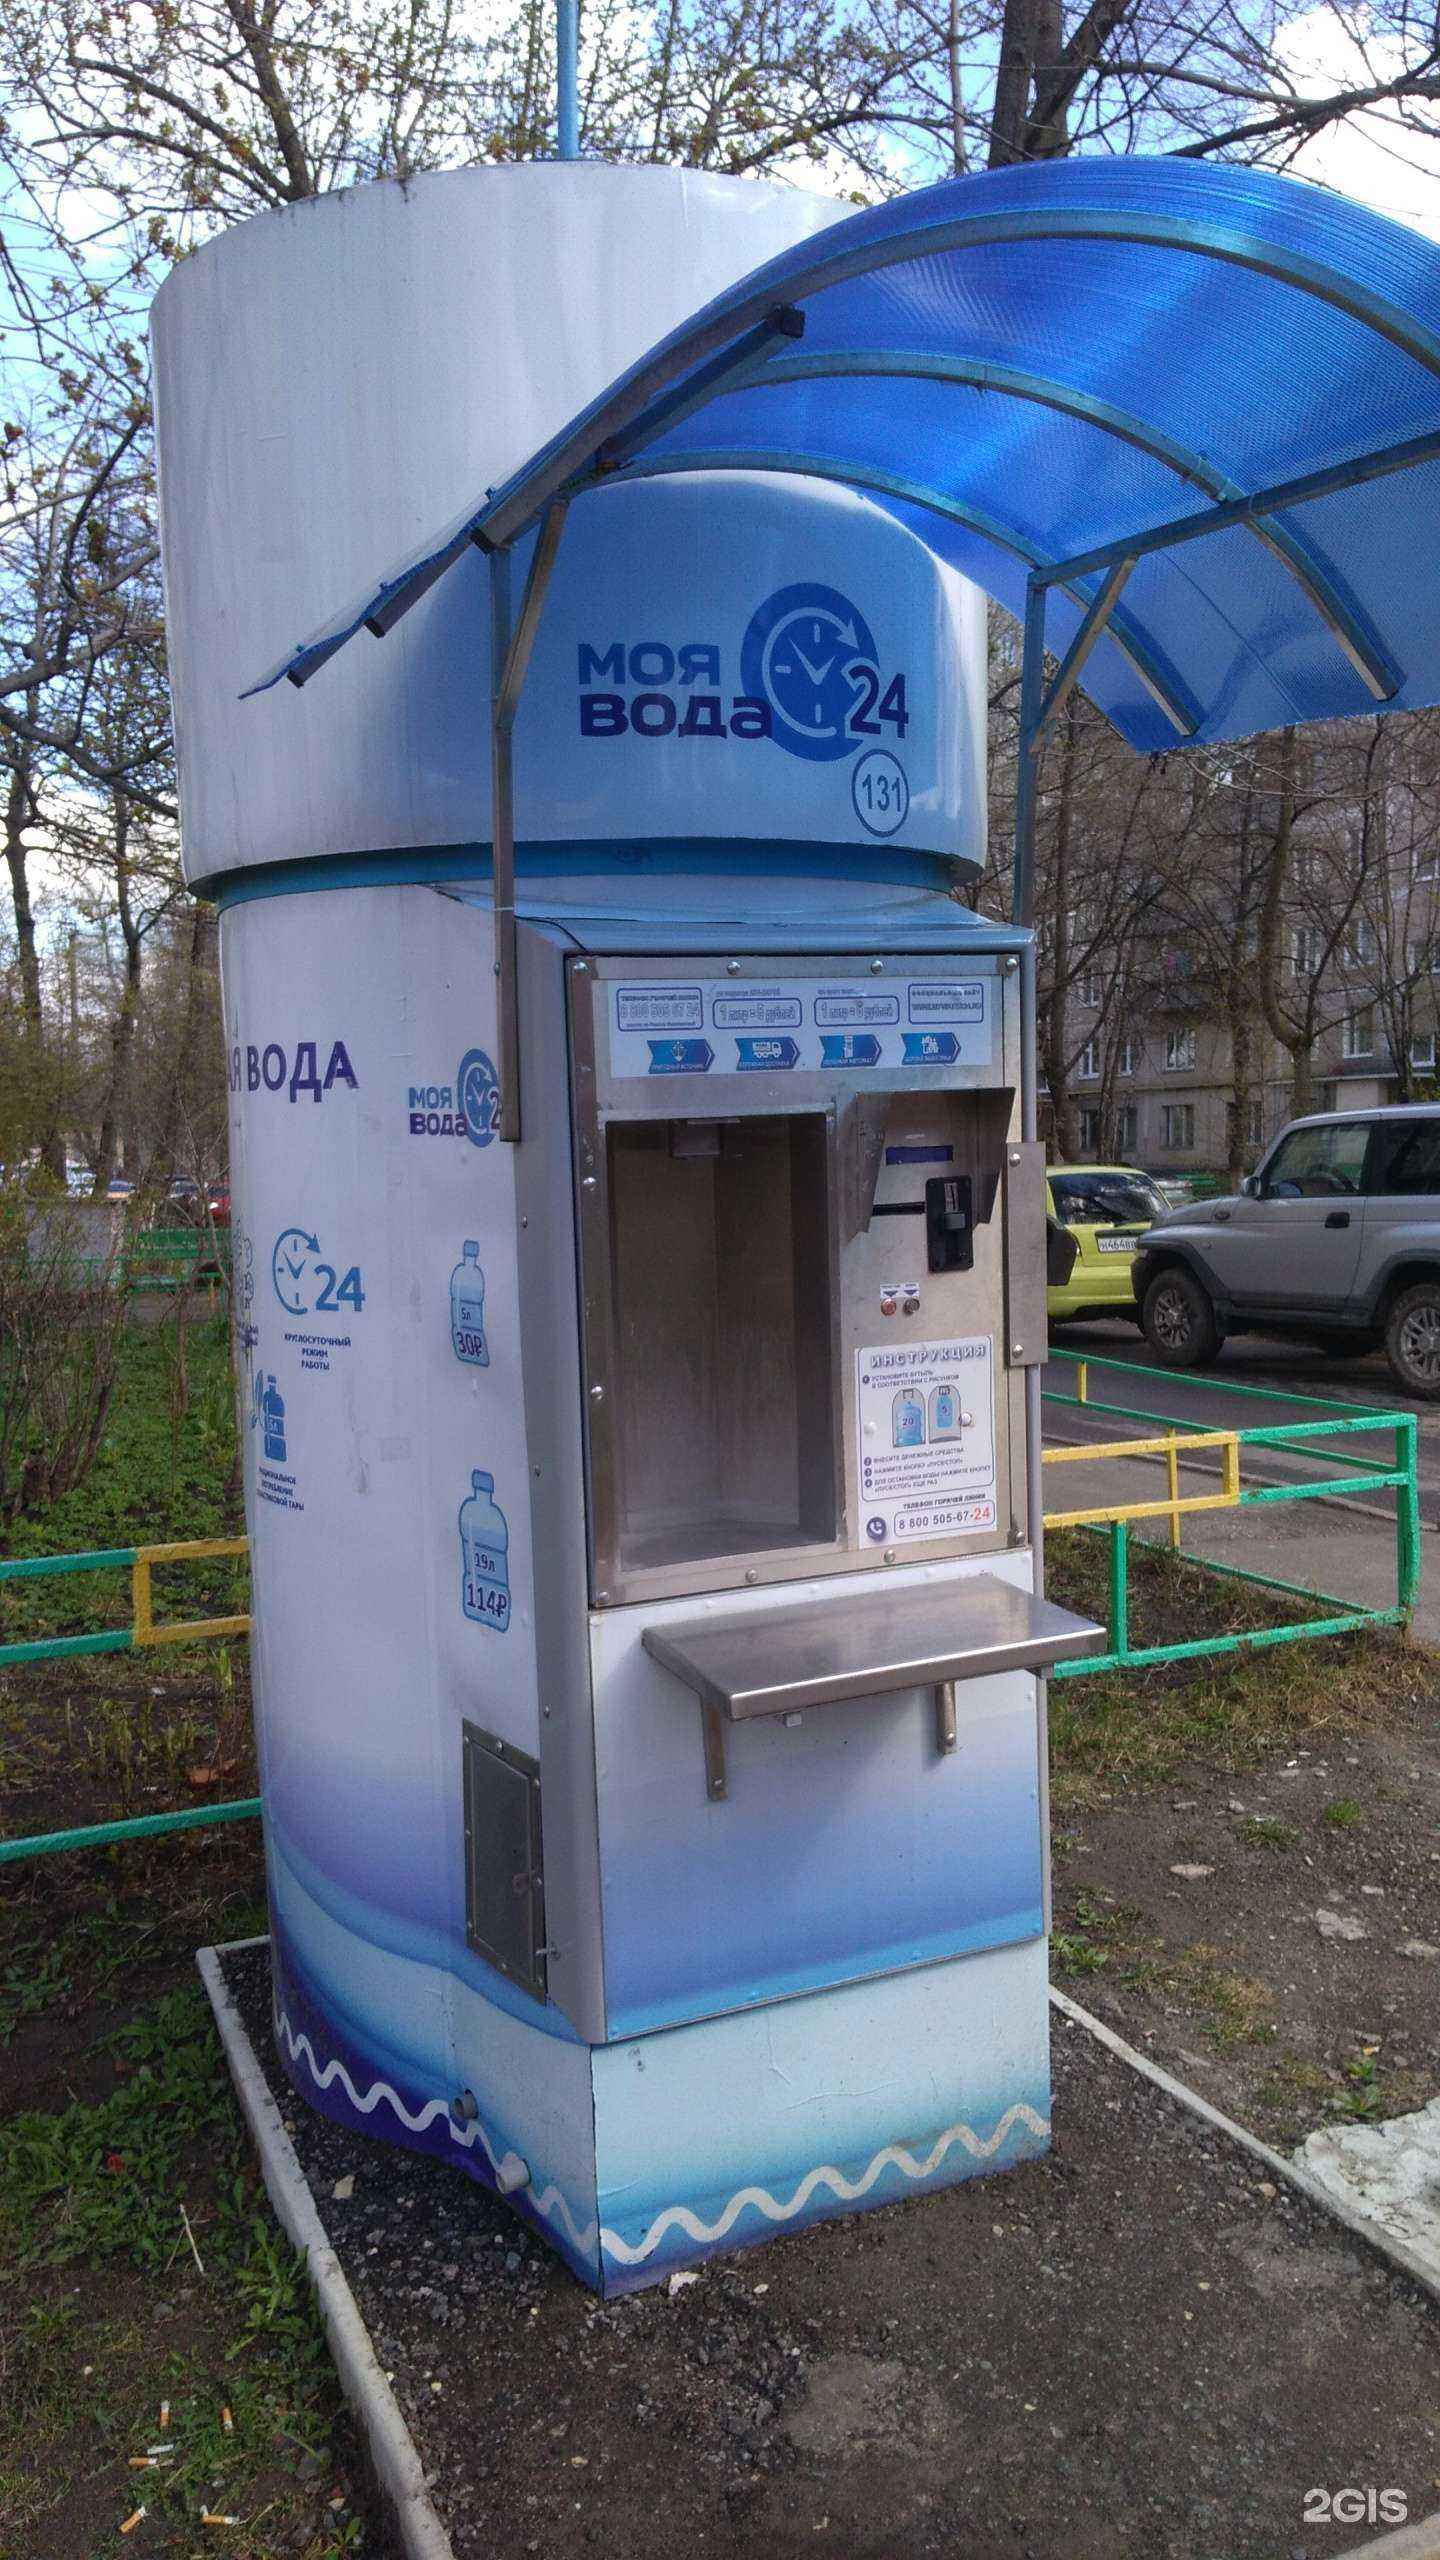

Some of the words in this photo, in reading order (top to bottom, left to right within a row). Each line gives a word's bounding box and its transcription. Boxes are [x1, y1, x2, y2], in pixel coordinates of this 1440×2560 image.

[850, 664, 909, 739] 24
[862, 773, 901, 812] 131
[247, 1041, 359, 1103] ВОДА
[490, 1090, 500, 1131] 2
[314, 1264, 366, 1312] 24
[461, 1307, 472, 1320] 5л
[284, 1333, 351, 1347] КРУГЛОСУТОЧНЫЙ
[302, 1348, 328, 1358] РЕЖИМ
[871, 1346, 986, 1368] ИНСТРУКЦИЯ
[301, 1360, 330, 1370] РАБОТЫ
[902, 1417, 914, 1426] 20
[903, 1500, 933, 1509] ТЕЛЕФОН
[934, 1496, 963, 1506] ГОРЯЧЕЙ
[964, 1493, 986, 1502] ЛИНИИ
[899, 1519, 905, 1530] 8
[909, 1516, 929, 1528] 800
[933, 1507, 990, 1525] 505-67-24
[474, 1552, 496, 1573] 19л
